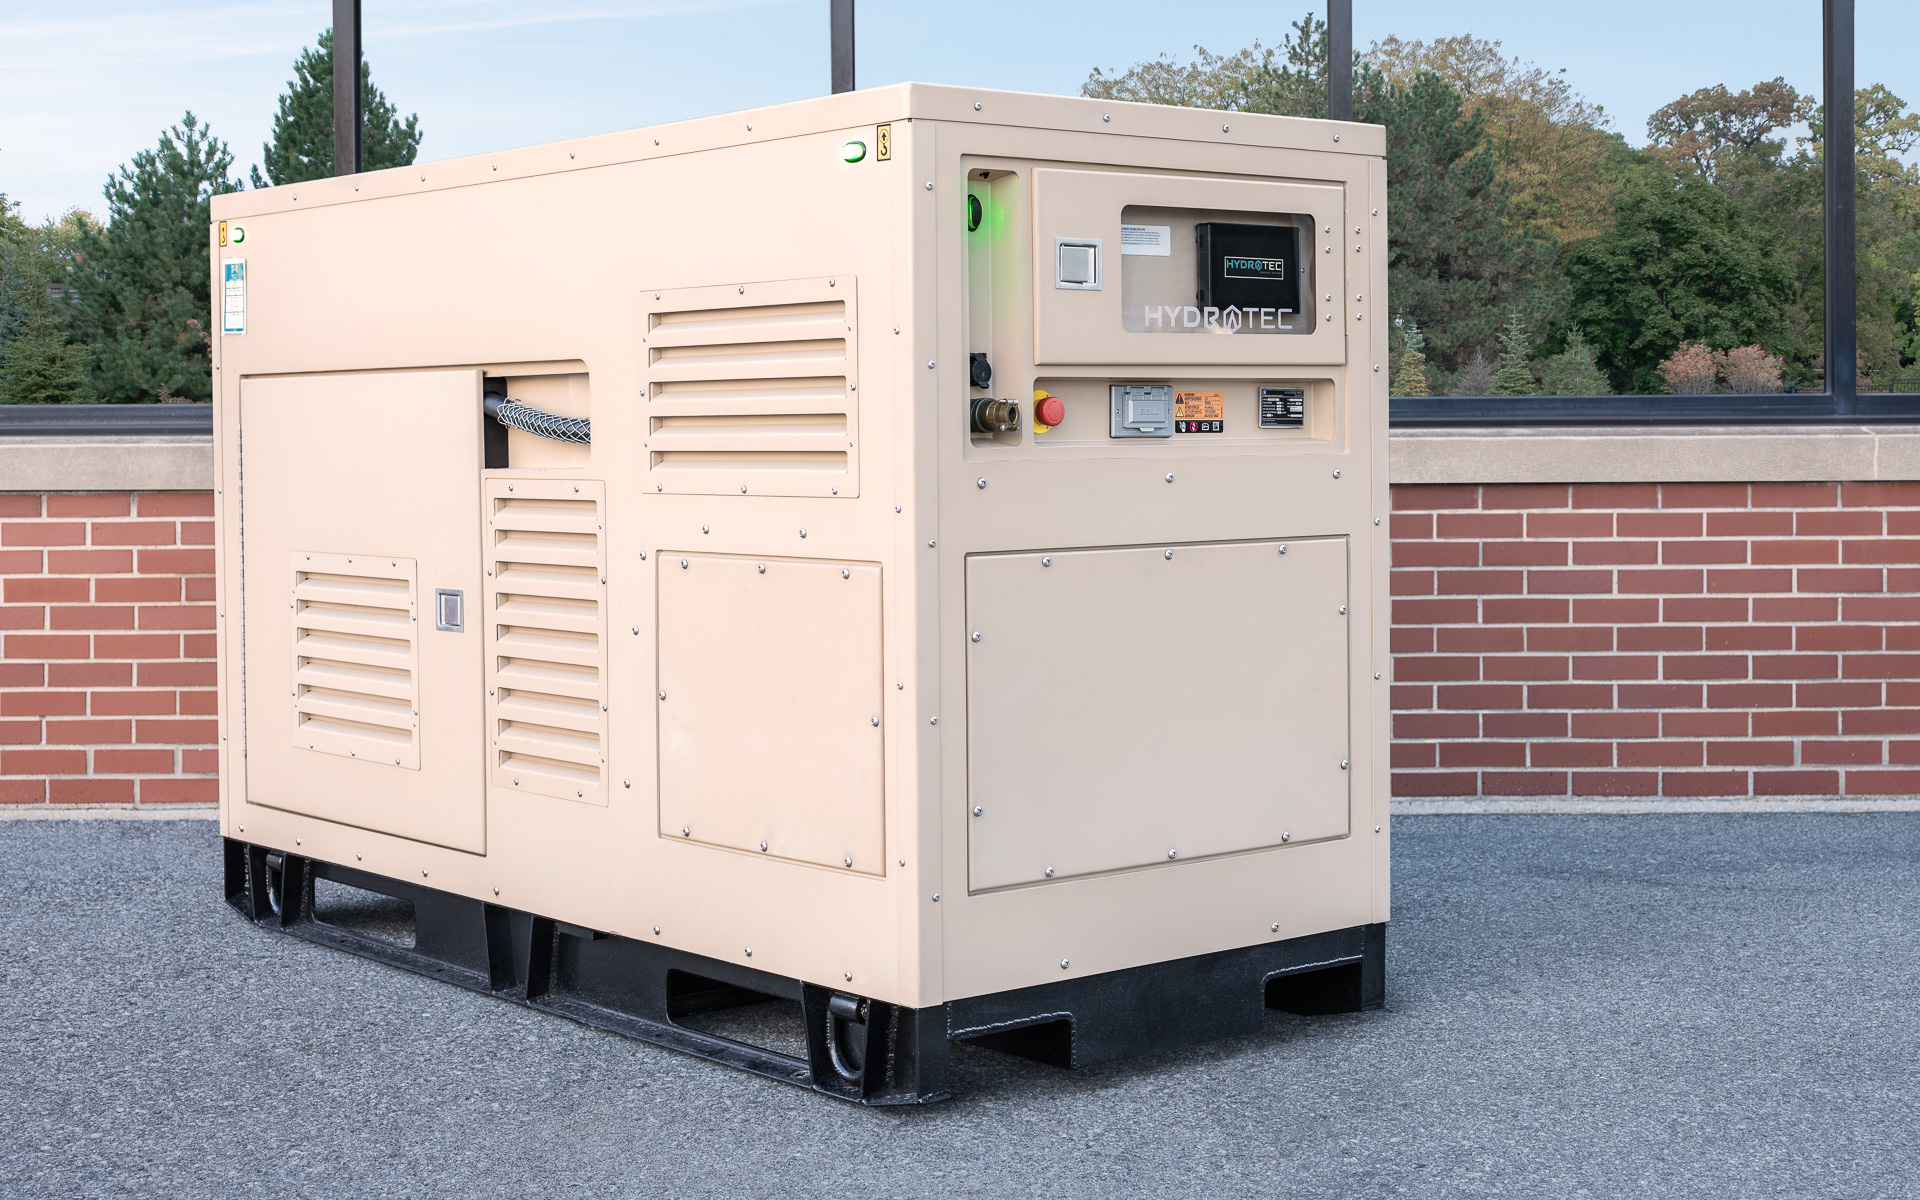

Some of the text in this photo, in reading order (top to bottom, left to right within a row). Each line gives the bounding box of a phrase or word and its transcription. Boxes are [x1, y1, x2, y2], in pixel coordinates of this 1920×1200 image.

[1226, 259, 1282, 271] HYDROTEC
[1144, 304, 1293, 333] HYDROTEC
[1139, 407, 1159, 415] BELL
